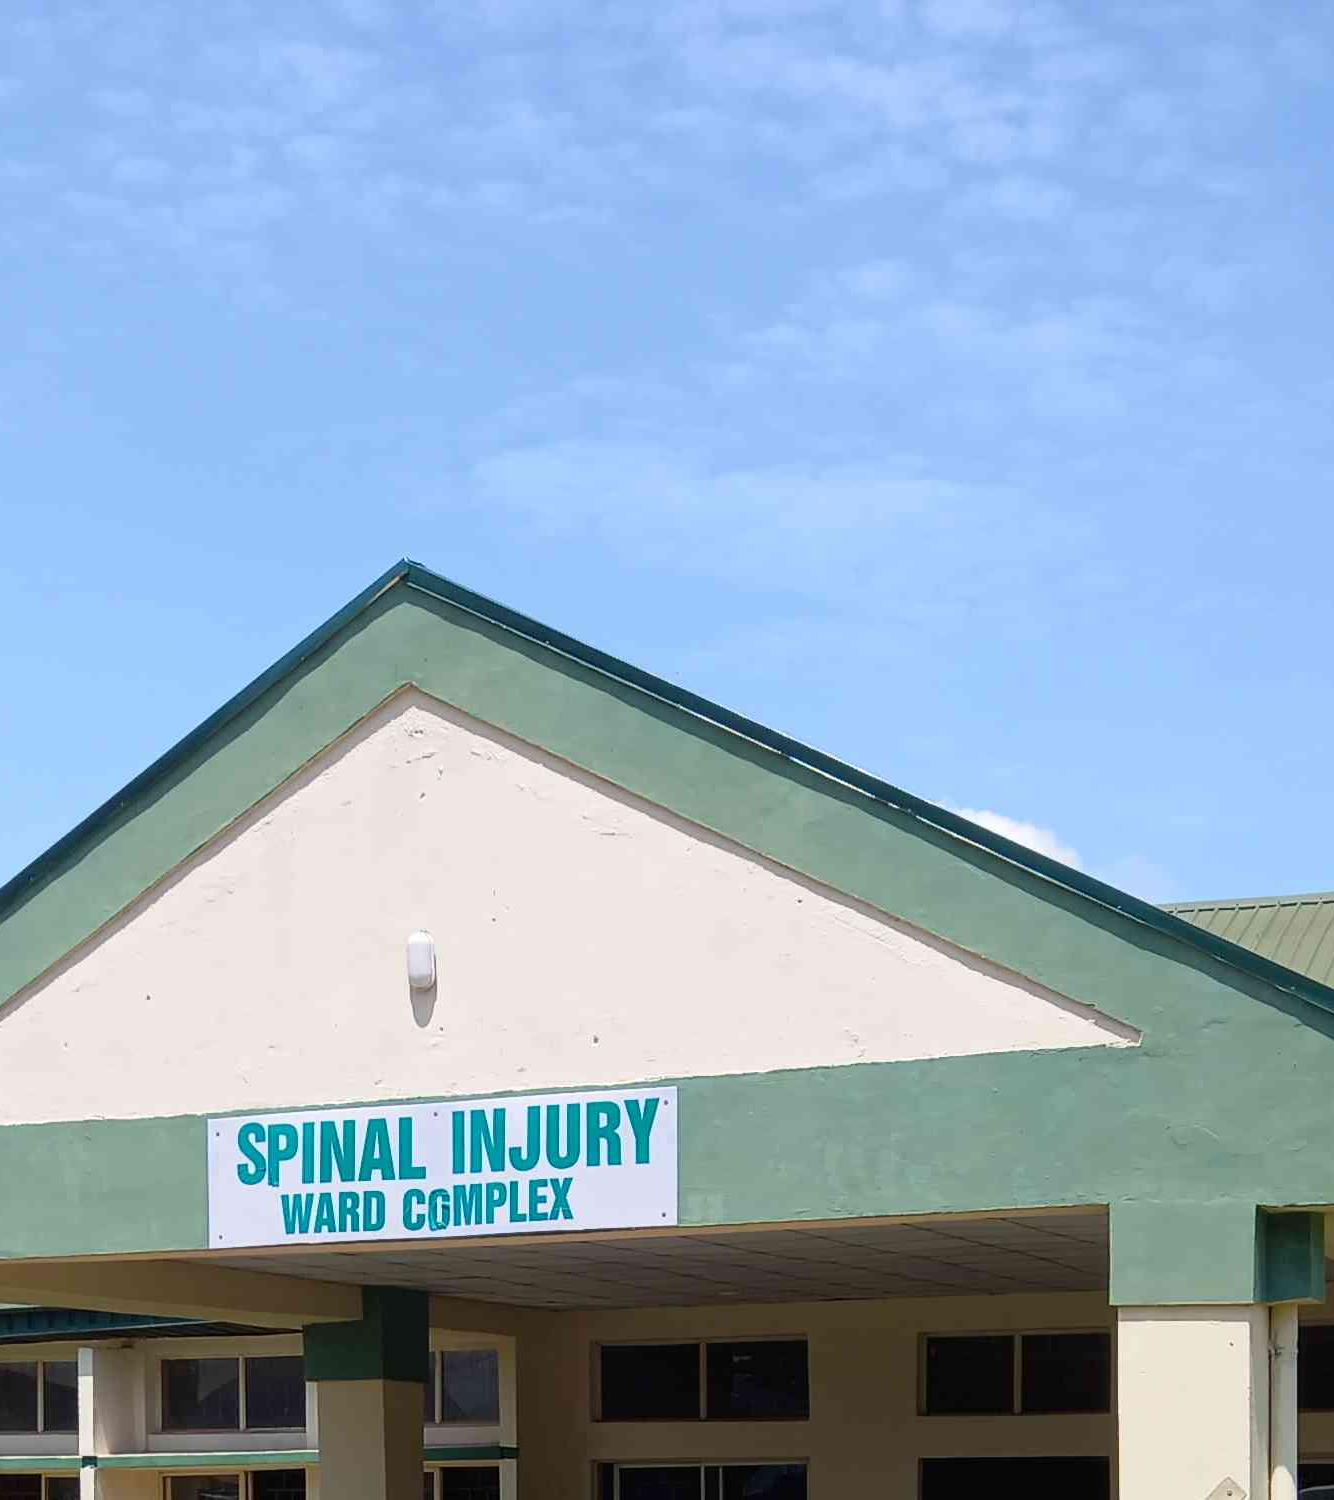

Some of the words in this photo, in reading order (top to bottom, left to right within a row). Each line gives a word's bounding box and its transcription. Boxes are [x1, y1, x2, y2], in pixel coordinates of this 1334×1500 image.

[237, 1117, 427, 1187] SPINAL
[452, 1098, 660, 1174] INJURY
[281, 1190, 386, 1234] WARD
[403, 1178, 574, 1231] COMPLEX
